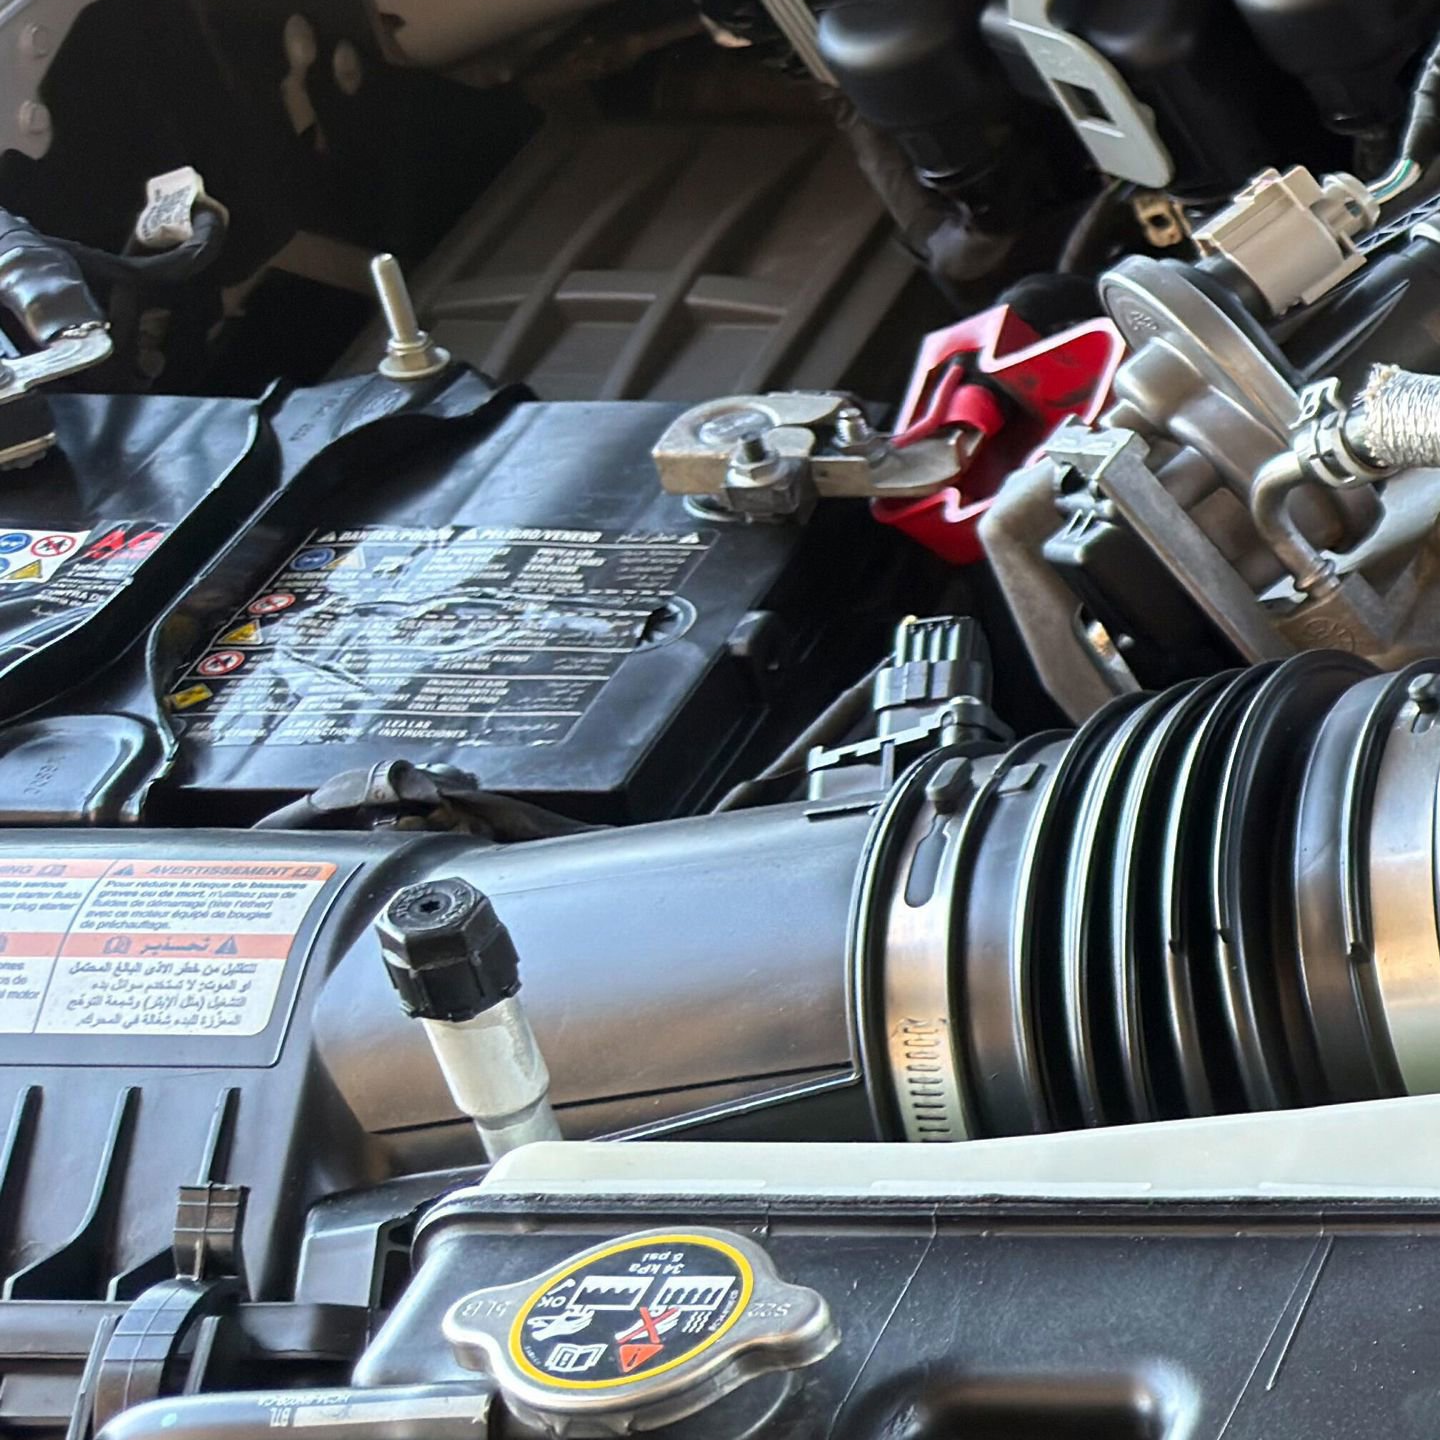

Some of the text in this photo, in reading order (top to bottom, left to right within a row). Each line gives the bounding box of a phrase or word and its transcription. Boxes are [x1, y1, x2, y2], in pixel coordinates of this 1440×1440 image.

[145, 865, 293, 876] AVERTISSEMENT
[642, 1251, 674, 1264] psi
[628, 1262, 685, 1275] 34 kPa
[539, 1296, 568, 1309] OK
